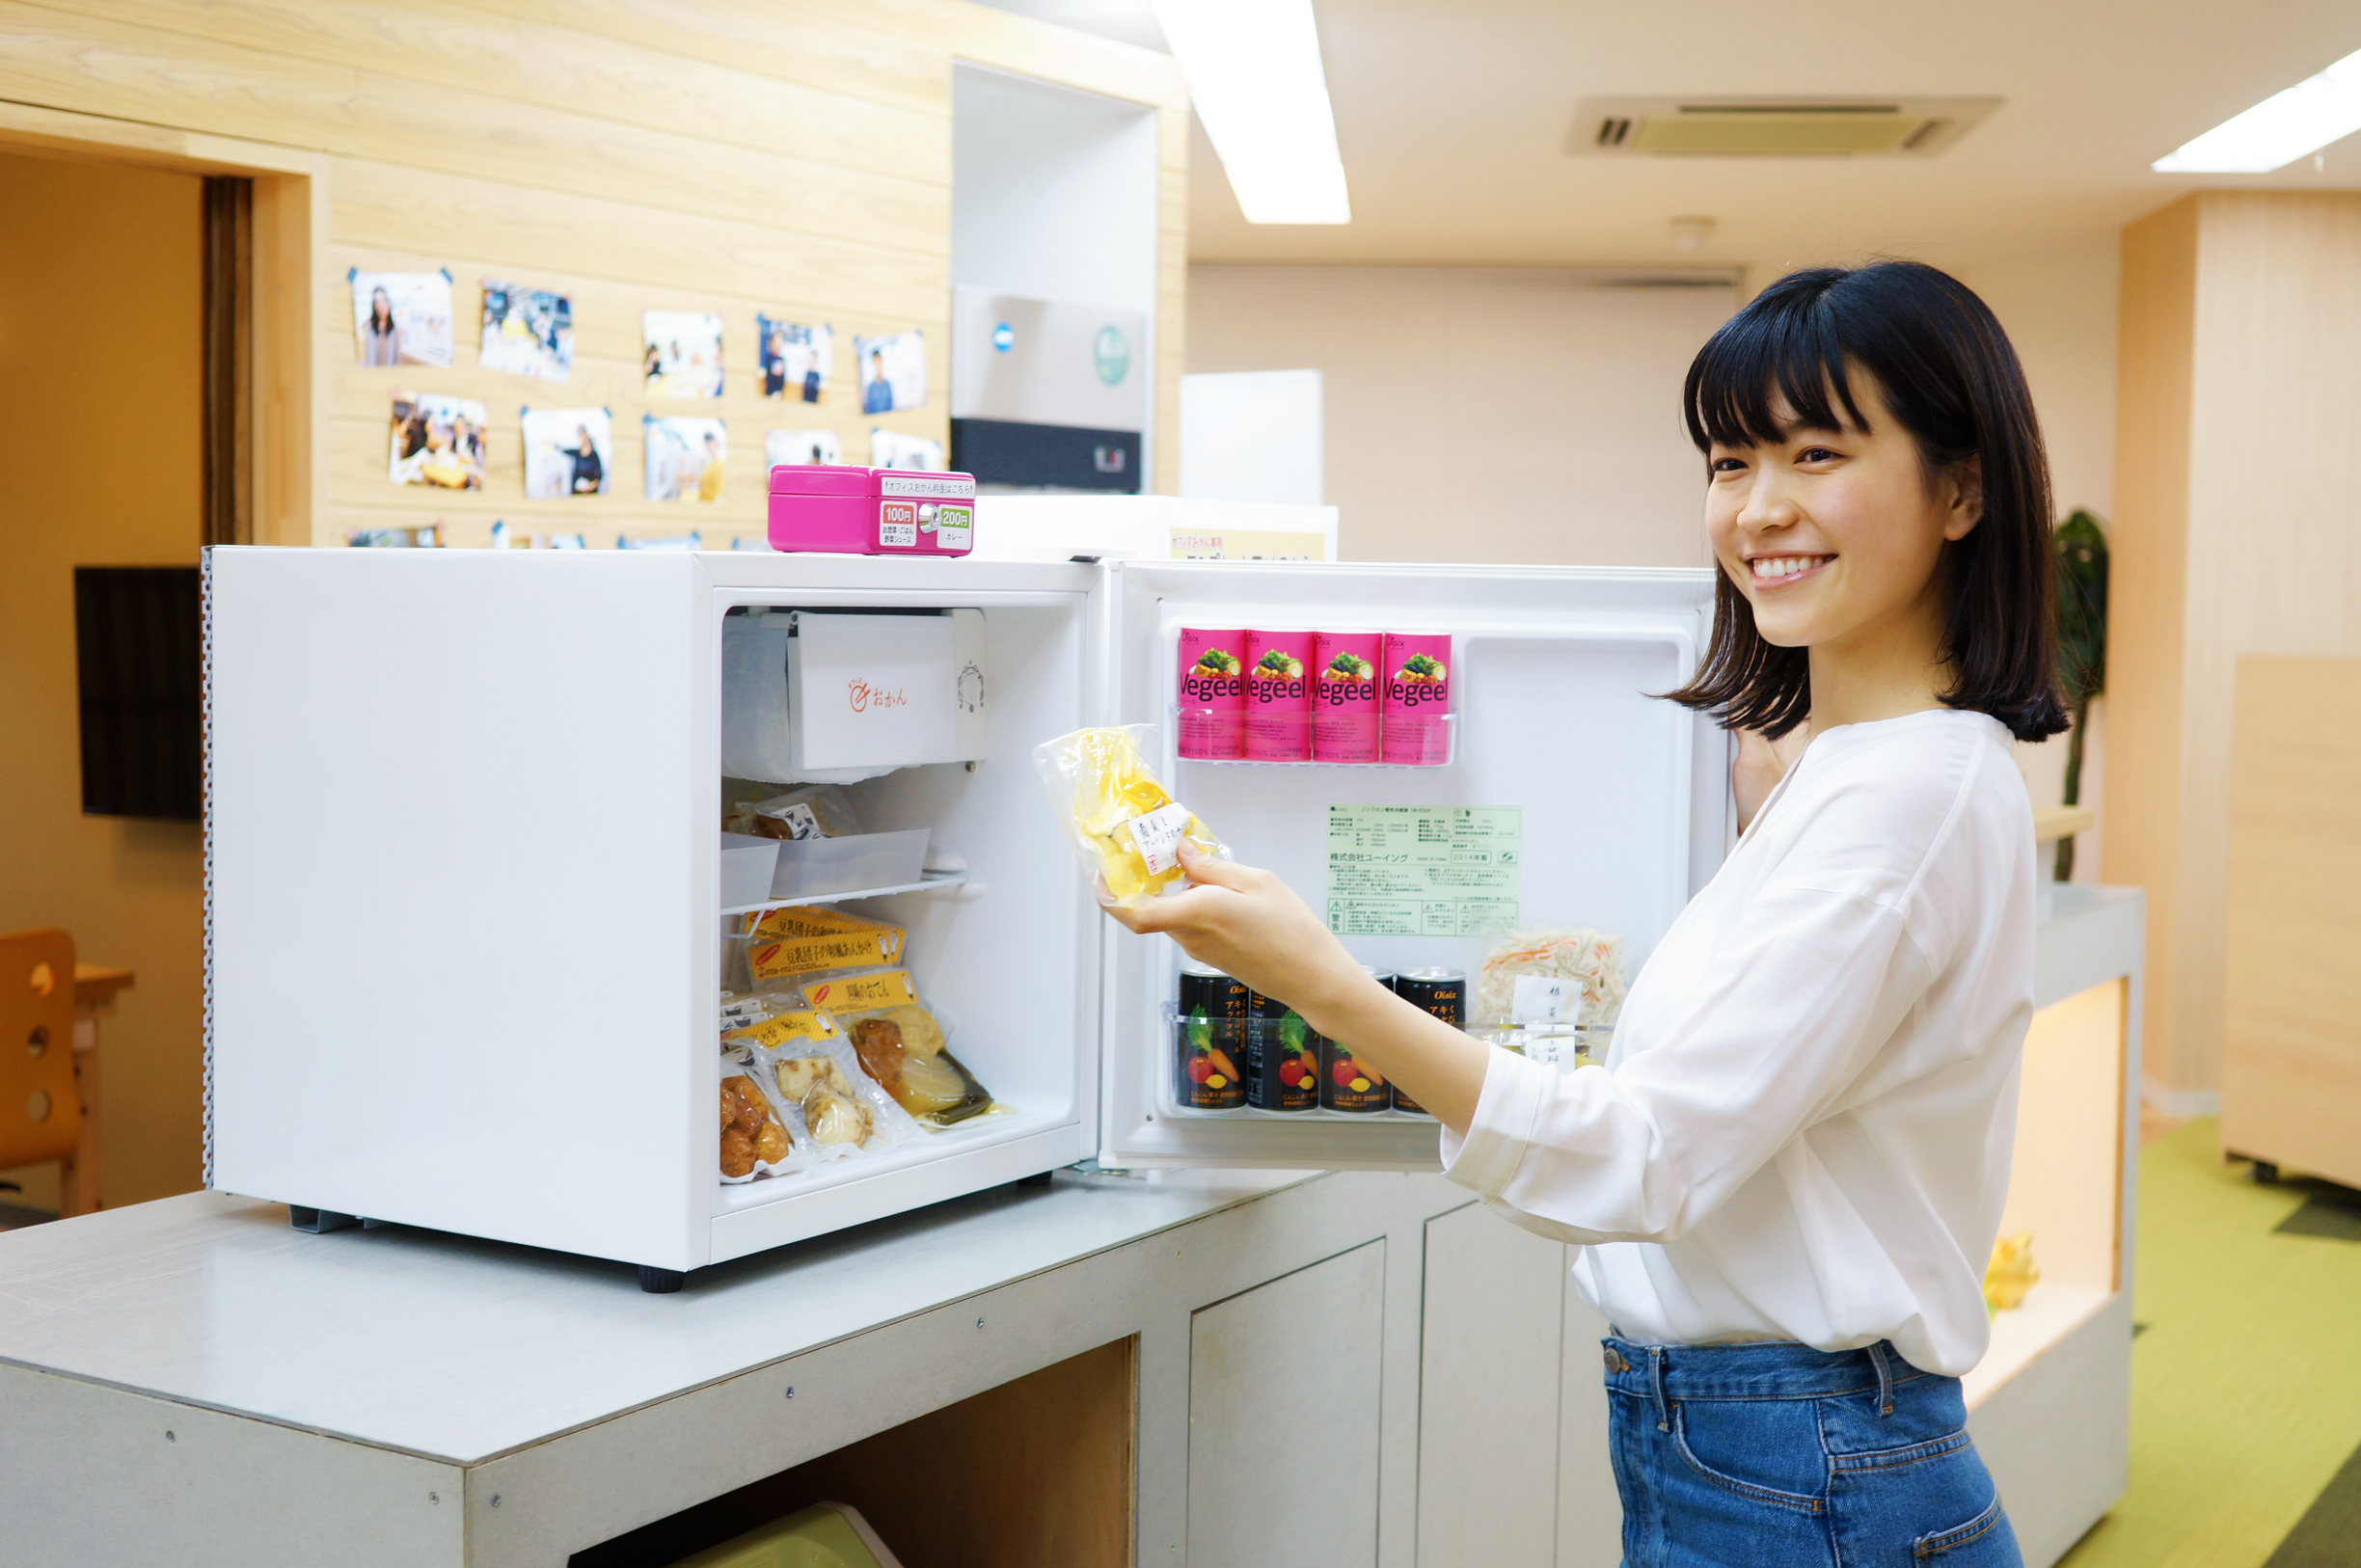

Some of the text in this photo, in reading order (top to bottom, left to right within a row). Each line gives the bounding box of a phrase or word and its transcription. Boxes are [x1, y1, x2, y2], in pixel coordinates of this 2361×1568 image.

[886, 507, 911, 523] 100円
[942, 511, 968, 527] 200円
[873, 688, 908, 708] おかん
[1383, 676, 1449, 707] Vegeel
[1330, 852, 1409, 862] 株式会社ユーイング
[1433, 990, 1456, 999] Oisix
